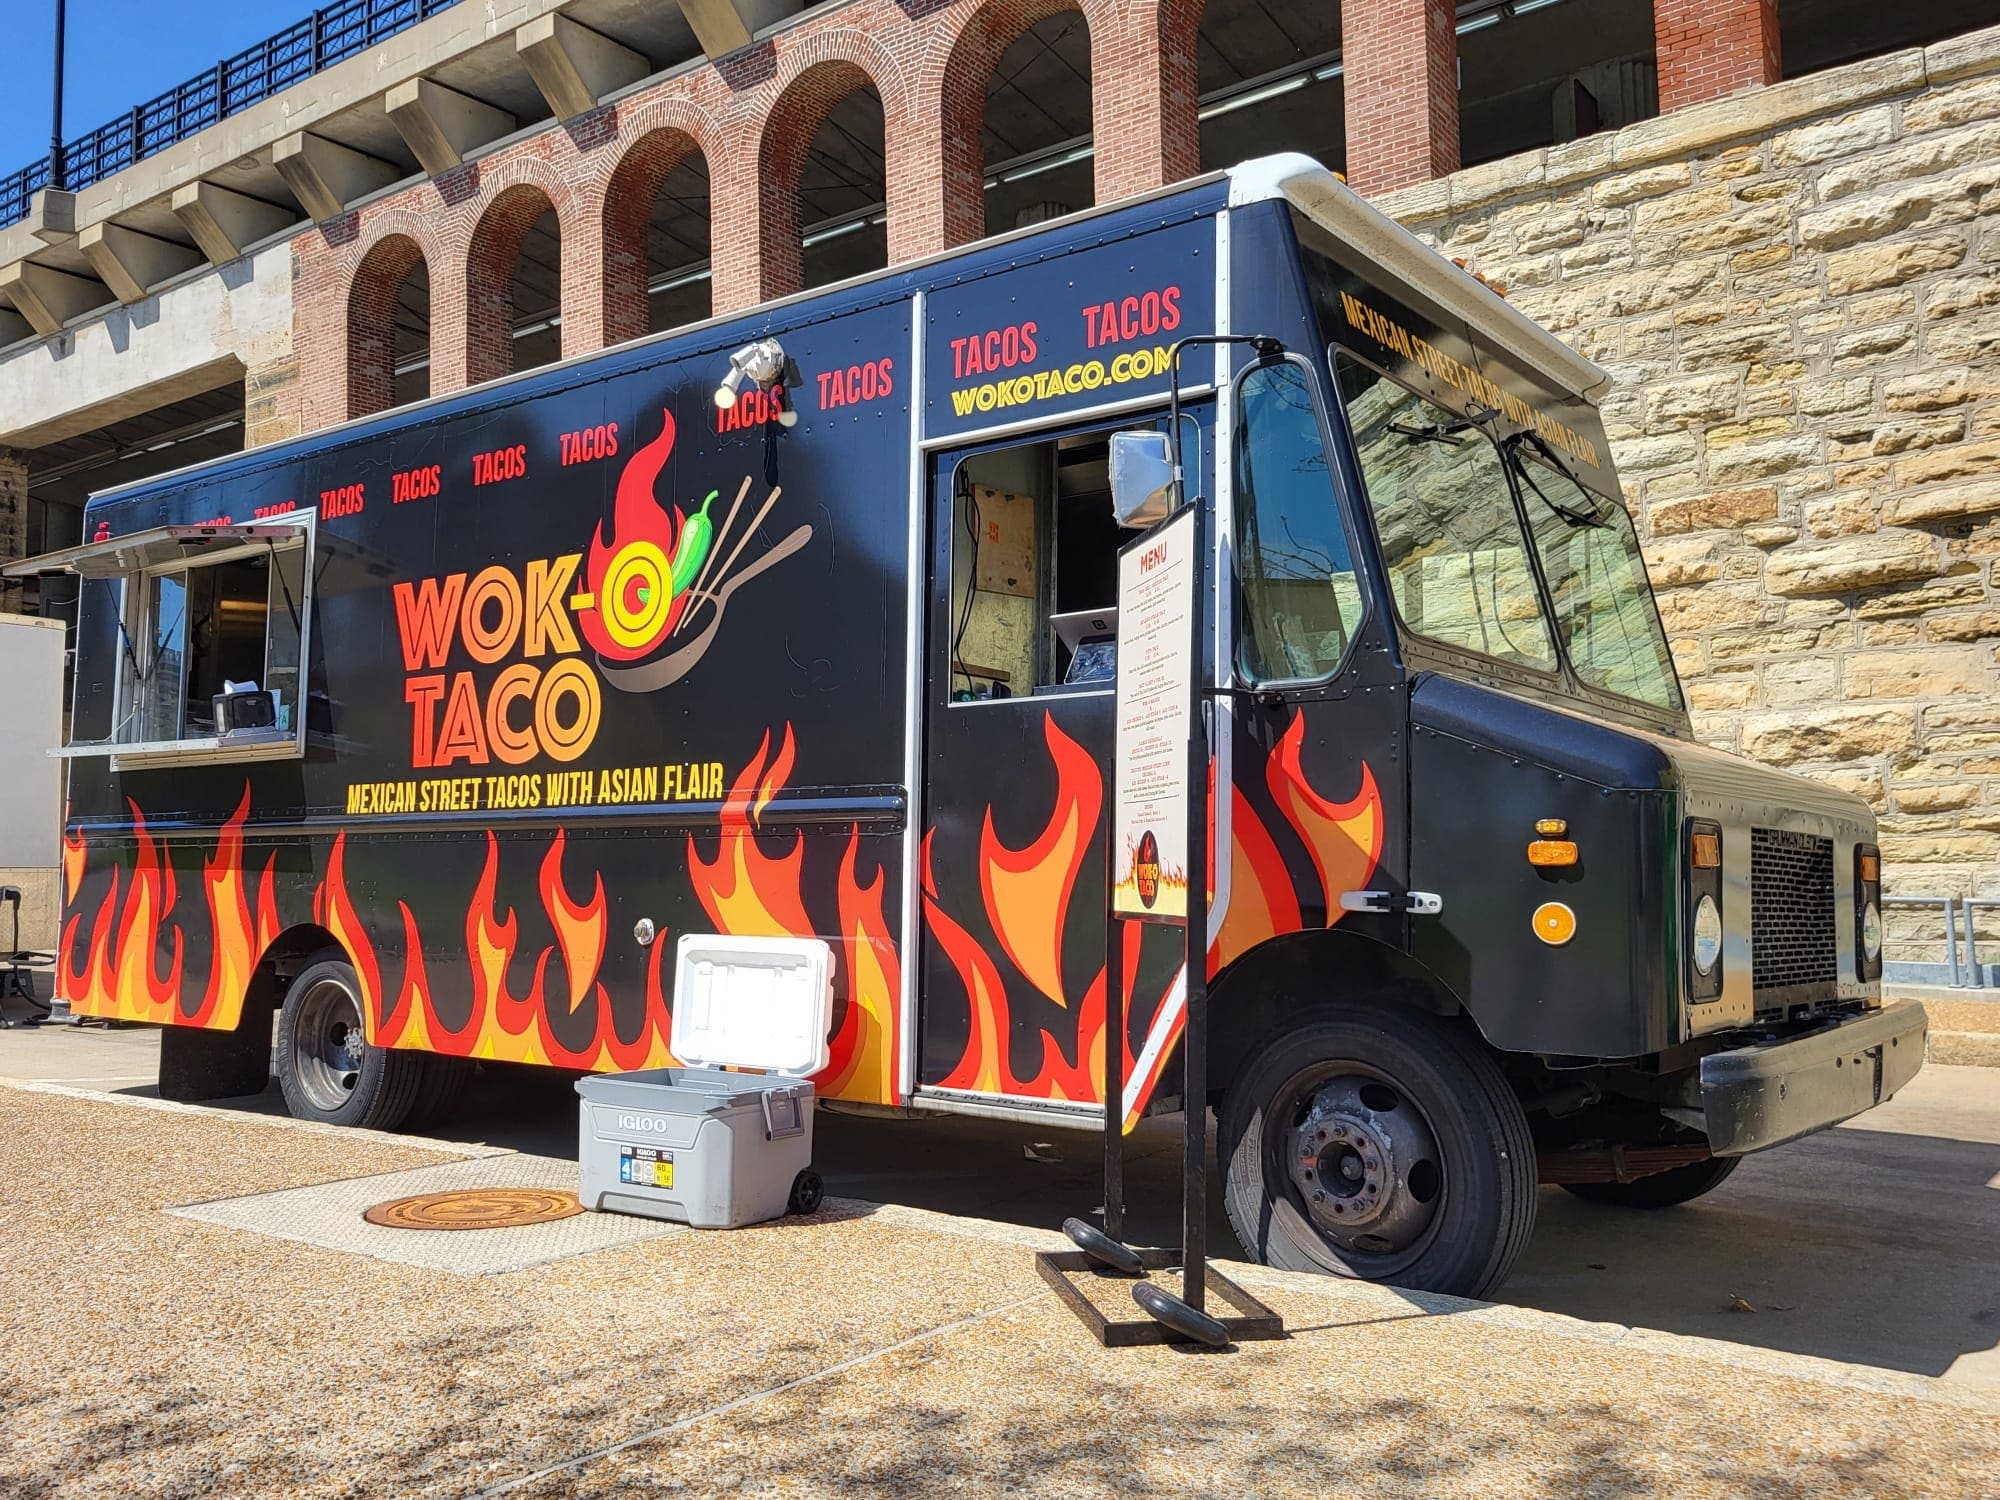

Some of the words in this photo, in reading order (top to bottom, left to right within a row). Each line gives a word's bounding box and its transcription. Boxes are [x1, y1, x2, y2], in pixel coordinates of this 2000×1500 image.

[952, 322, 1037, 379] TACOS
[1083, 285, 1181, 348] TACOS
[952, 343, 1180, 416] WOKOTACO.COM
[1340, 291, 1414, 361] MEXICAN
[1411, 335, 1465, 391] STREET
[1461, 365, 1505, 414] TACOS
[1501, 388, 1536, 429] WITH
[1534, 408, 1570, 452] ASIAN
[1566, 427, 1600, 470] FLAIR
[320, 483, 365, 521] TACOS
[392, 464, 441, 504] TACOS
[472, 444, 526, 486] TACOS
[560, 422, 618, 466] TACOS
[817, 358, 893, 410] TACOS
[1140, 541, 1168, 575] MENU
[393, 541, 673, 671] WOK-O
[405, 658, 601, 768] TACO
[346, 781, 417, 814] MEXICAN
[419, 777, 482, 812] STREET
[485, 774, 542, 809] TACOS
[546, 770, 594, 806] WITH
[597, 766, 658, 804] ASIAN
[663, 762, 724, 800] FLAIR
[617, 1114, 667, 1134] IGLOO
